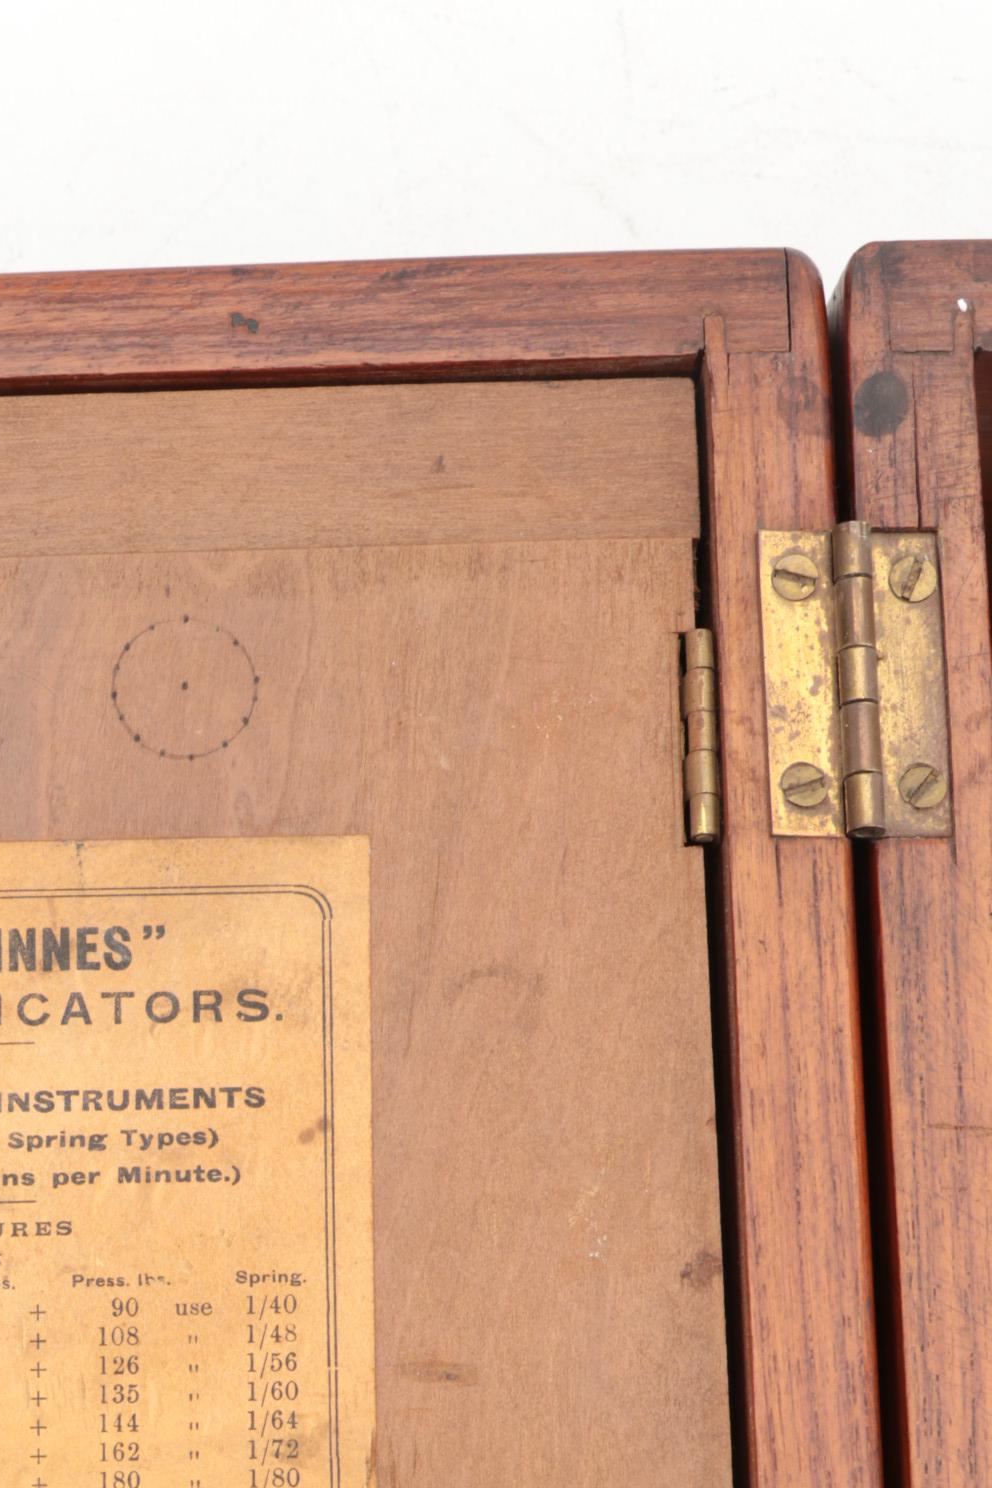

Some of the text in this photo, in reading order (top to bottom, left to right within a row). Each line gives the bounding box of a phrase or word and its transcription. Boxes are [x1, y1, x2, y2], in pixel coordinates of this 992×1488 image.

[8, 1131, 108, 1152] Spring
[120, 1128, 219, 1151] Types)
[53, 1172, 100, 1189] per
[118, 1165, 241, 1185] Minute.)
[73, 1274, 129, 1287] Press.
[236, 1270, 306, 1287] Spring.
[112, 1297, 139, 1317] 90
[176, 1303, 212, 1316] use
[247, 1294, 297, 1320] 1/40
[99, 1327, 139, 1346] 108
[247, 1324, 297, 1350] 1/48
[100, 1355, 139, 1375] 126
[247, 1352, 297, 1379] 1/56
[101, 1384, 139, 1404] 135
[248, 1380, 298, 1407] 1/60
[100, 1413, 138, 1432] 144
[248, 1410, 298, 1437] 1/64
[101, 1442, 139, 1461] 162
[249, 1438, 299, 1466] 1/72
